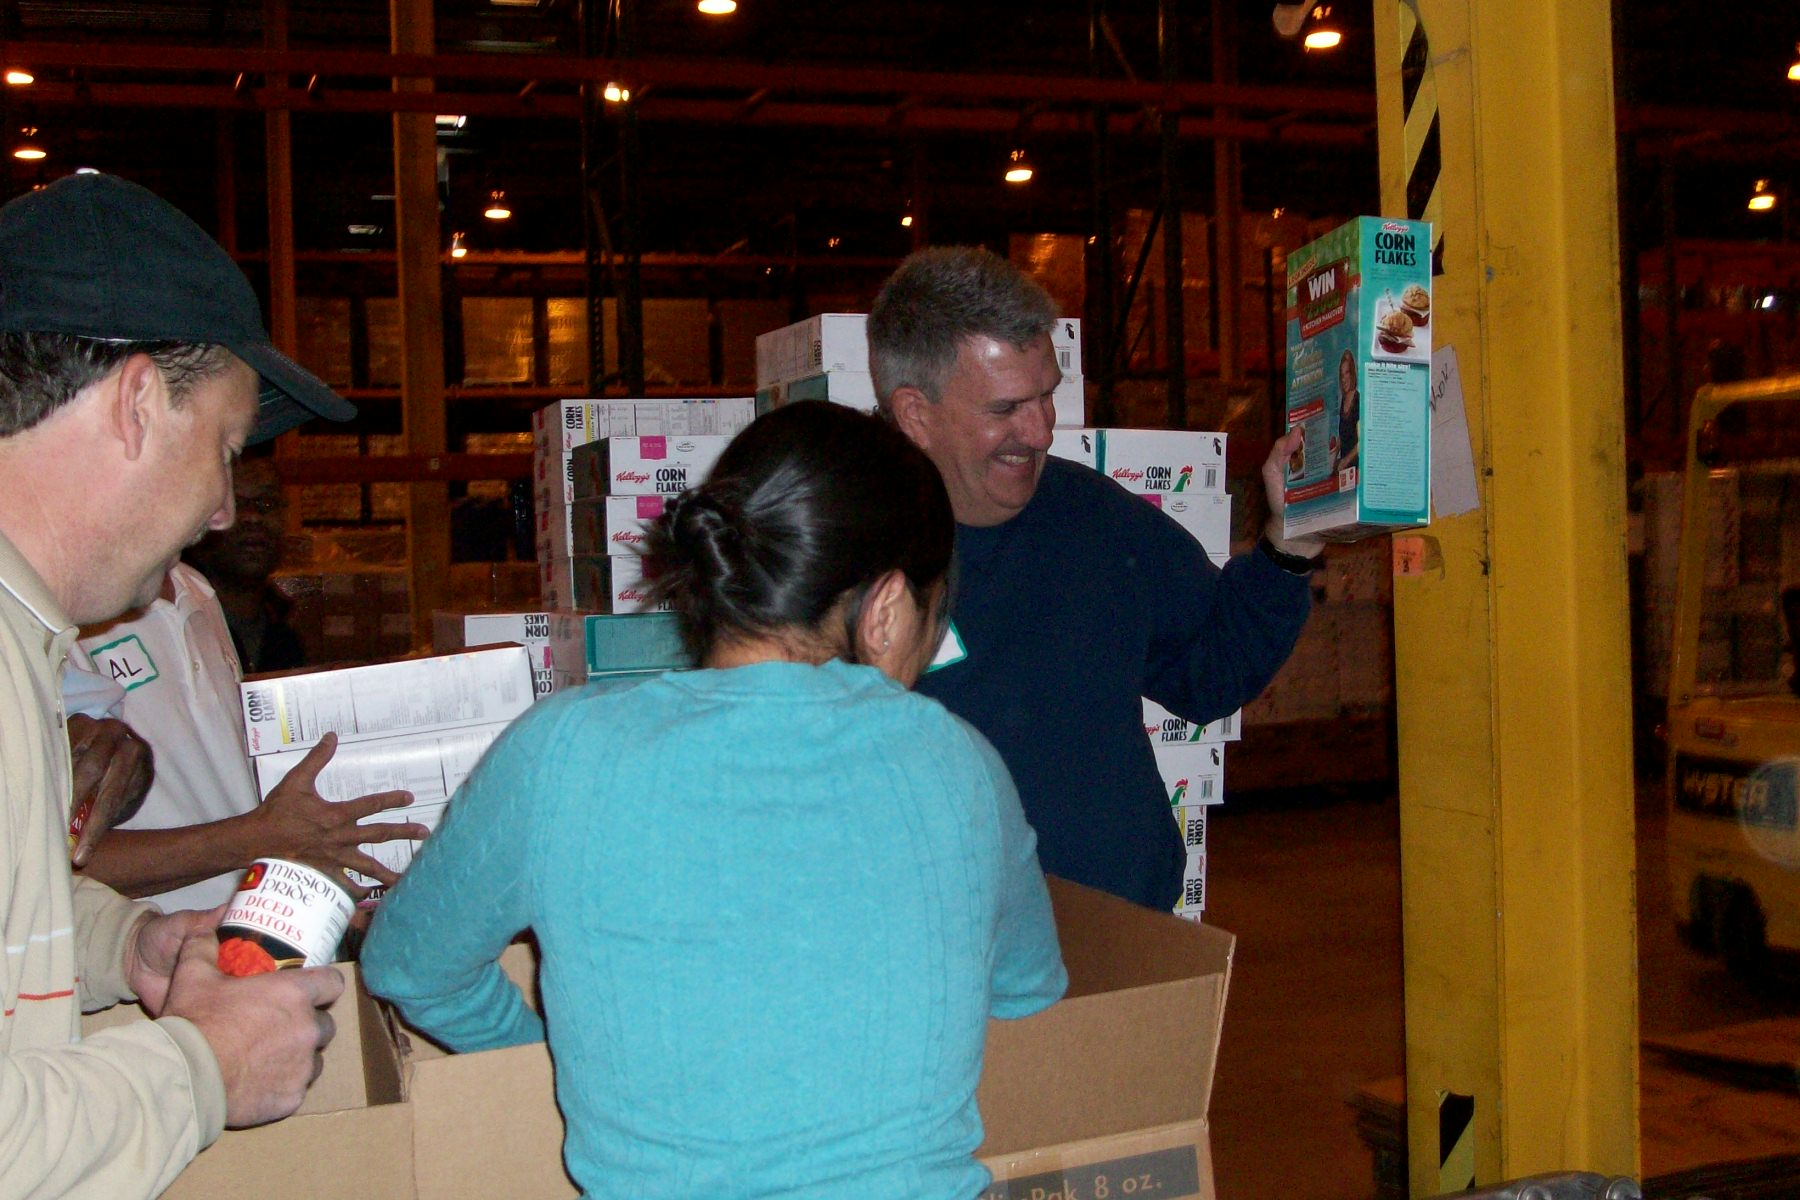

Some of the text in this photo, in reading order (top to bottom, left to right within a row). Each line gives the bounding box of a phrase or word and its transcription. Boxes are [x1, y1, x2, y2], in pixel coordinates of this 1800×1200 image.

[1382, 222, 1409, 233] Kellogg's
[1375, 232, 1415, 252] CORN
[1375, 250, 1416, 266] FLAKES
[1308, 268, 1335, 301] WIN
[565, 406, 575, 429] CORN
[616, 471, 651, 483] Kellogg's
[656, 468, 686, 481] CORN
[1113, 467, 1144, 481] Kellogg's
[1146, 466, 1171, 479] CORN
[656, 482, 688, 493] FLAKES
[1145, 480, 1171, 490] FLAKES
[524, 614, 549, 625] LAKES
[525, 625, 549, 638] ORN
[109, 657, 143, 680] AL
[247, 689, 263, 722] CORN
[1162, 718, 1188, 731] CORN
[1161, 731, 1187, 743] FLAKES
[1187, 820, 1195, 846] FLAKES
[1195, 819, 1203, 845] CORN
[1186, 879, 1194, 906] FLAKES
[1194, 878, 1203, 904] CORN
[245, 895, 294, 918] DICED
[227, 909, 304, 942] TOMATOES
[1095, 1176, 1109, 1199] 8
[1122, 1174, 1162, 1194] oz.
